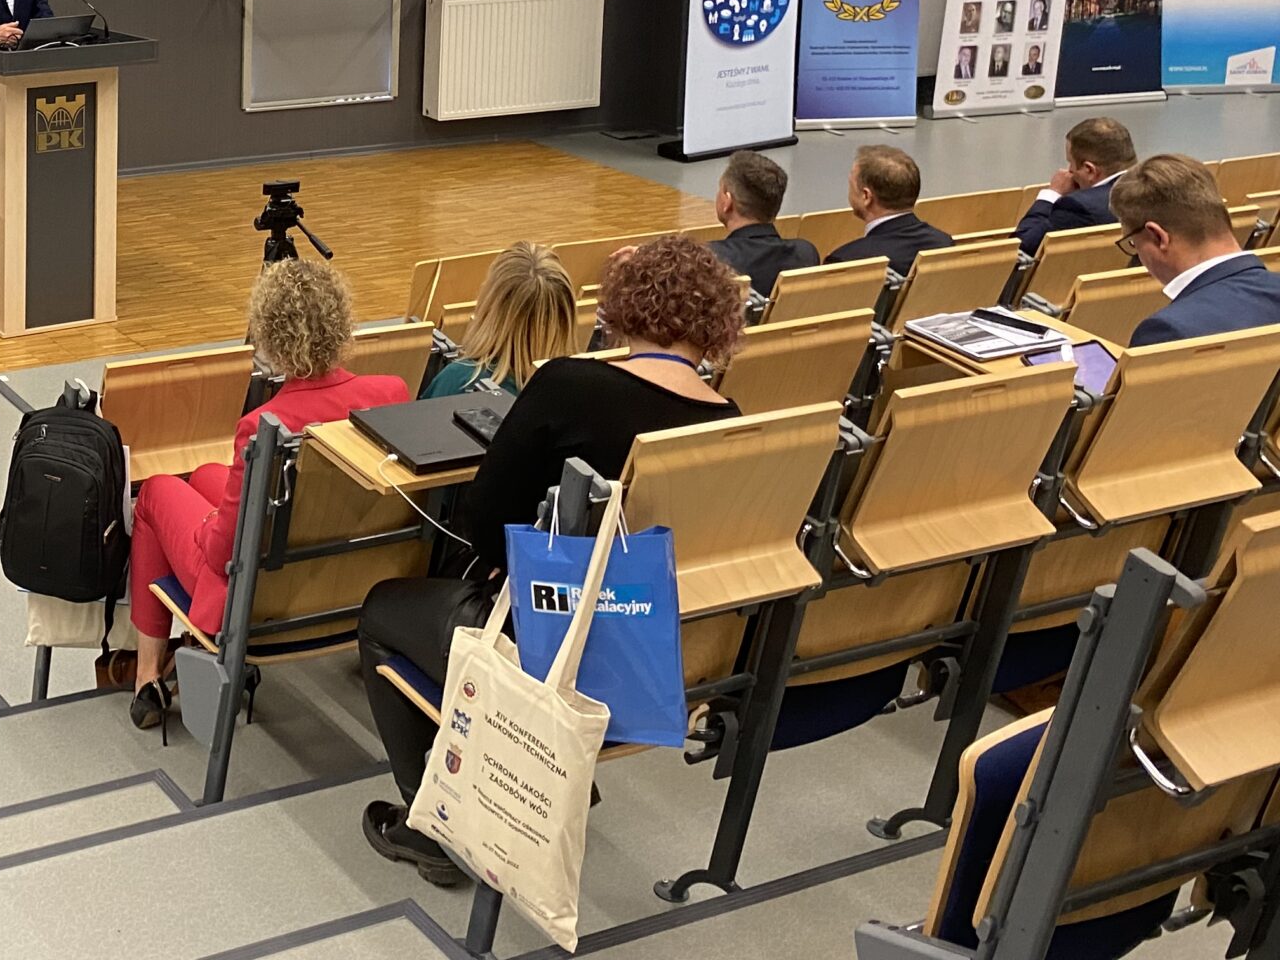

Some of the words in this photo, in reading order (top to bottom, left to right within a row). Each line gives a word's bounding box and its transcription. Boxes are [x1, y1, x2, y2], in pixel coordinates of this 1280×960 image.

[37, 130, 83, 151] PK
[533, 583, 569, 611] Ri
[571, 587, 616, 600] Rek
[572, 599, 652, 615] ialacyjny
[495, 710, 508, 723] XIV
[509, 720, 556, 760] KONFERENCJA
[483, 752, 518, 784] OCHRONA
[520, 781, 552, 808] JAKOŚCI
[488, 772, 527, 804] ZASOBÓW
[529, 800, 548, 819] WÓD
